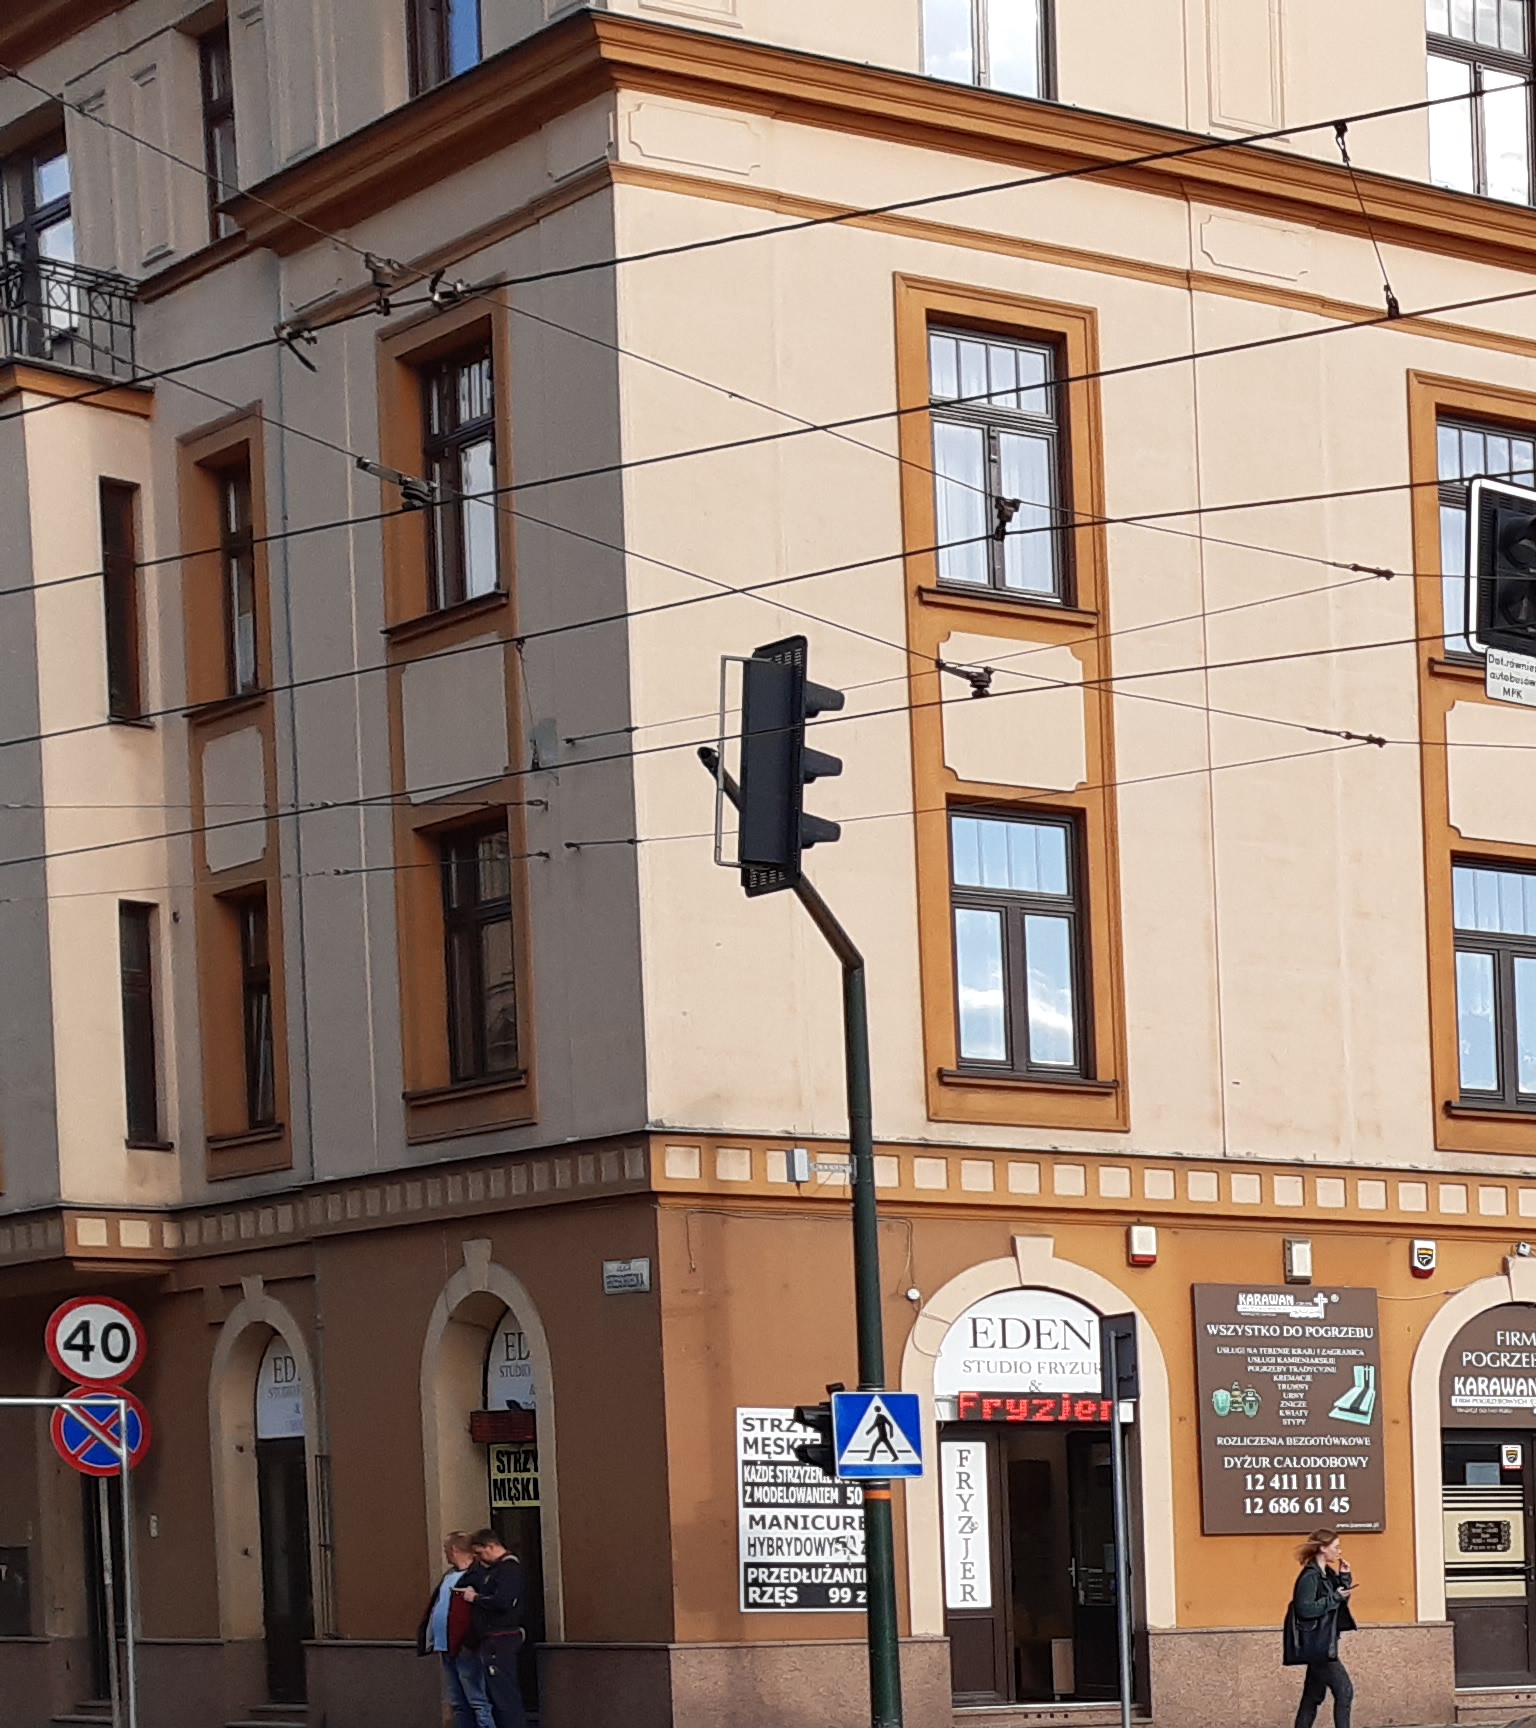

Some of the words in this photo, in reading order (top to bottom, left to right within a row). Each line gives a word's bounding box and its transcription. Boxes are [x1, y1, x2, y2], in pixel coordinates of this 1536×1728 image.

[1502, 686, 1523, 699] MPK
[1238, 1292, 1295, 1306] KARAWAN
[967, 1316, 1094, 1351] EDEN
[1206, 1324, 1280, 1337] WSZYSTKO
[1282, 1326, 1303, 1337] DO
[1304, 1327, 1374, 1339] POGRZEBU
[63, 1319, 131, 1364] 40
[273, 1356, 302, 1384] ED
[962, 1359, 1032, 1374] STUDIO
[1028, 1379, 1042, 1393] &
[958, 1391, 1113, 1422] Fryzjer
[1216, 1436, 1284, 1446] ROZLICZENIA
[1285, 1434, 1371, 1446] BEZGOTÓWKOWE
[1223, 1454, 1272, 1469] DYŻUR
[1273, 1456, 1369, 1469] CAŁODOBOWY
[743, 1461, 774, 1483] KAŻDE
[1244, 1473, 1265, 1491] 12
[1269, 1473, 1299, 1490] 411
[1305, 1473, 1322, 1490] 11
[1329, 1473, 1347, 1490] 11
[744, 1486, 752, 1503] Z
[753, 1486, 839, 1504] MODELOWANIEM
[846, 1487, 863, 1505] 50
[1243, 1497, 1264, 1514] 12
[1268, 1497, 1300, 1514] 686
[1304, 1497, 1324, 1514] 61
[1328, 1496, 1350, 1513] 45
[955, 1448, 979, 1603] FRYZJER
[747, 1536, 836, 1557] HYBRYDOWY
[748, 1586, 799, 1607] RZĘS
[828, 1587, 851, 1604] 99
